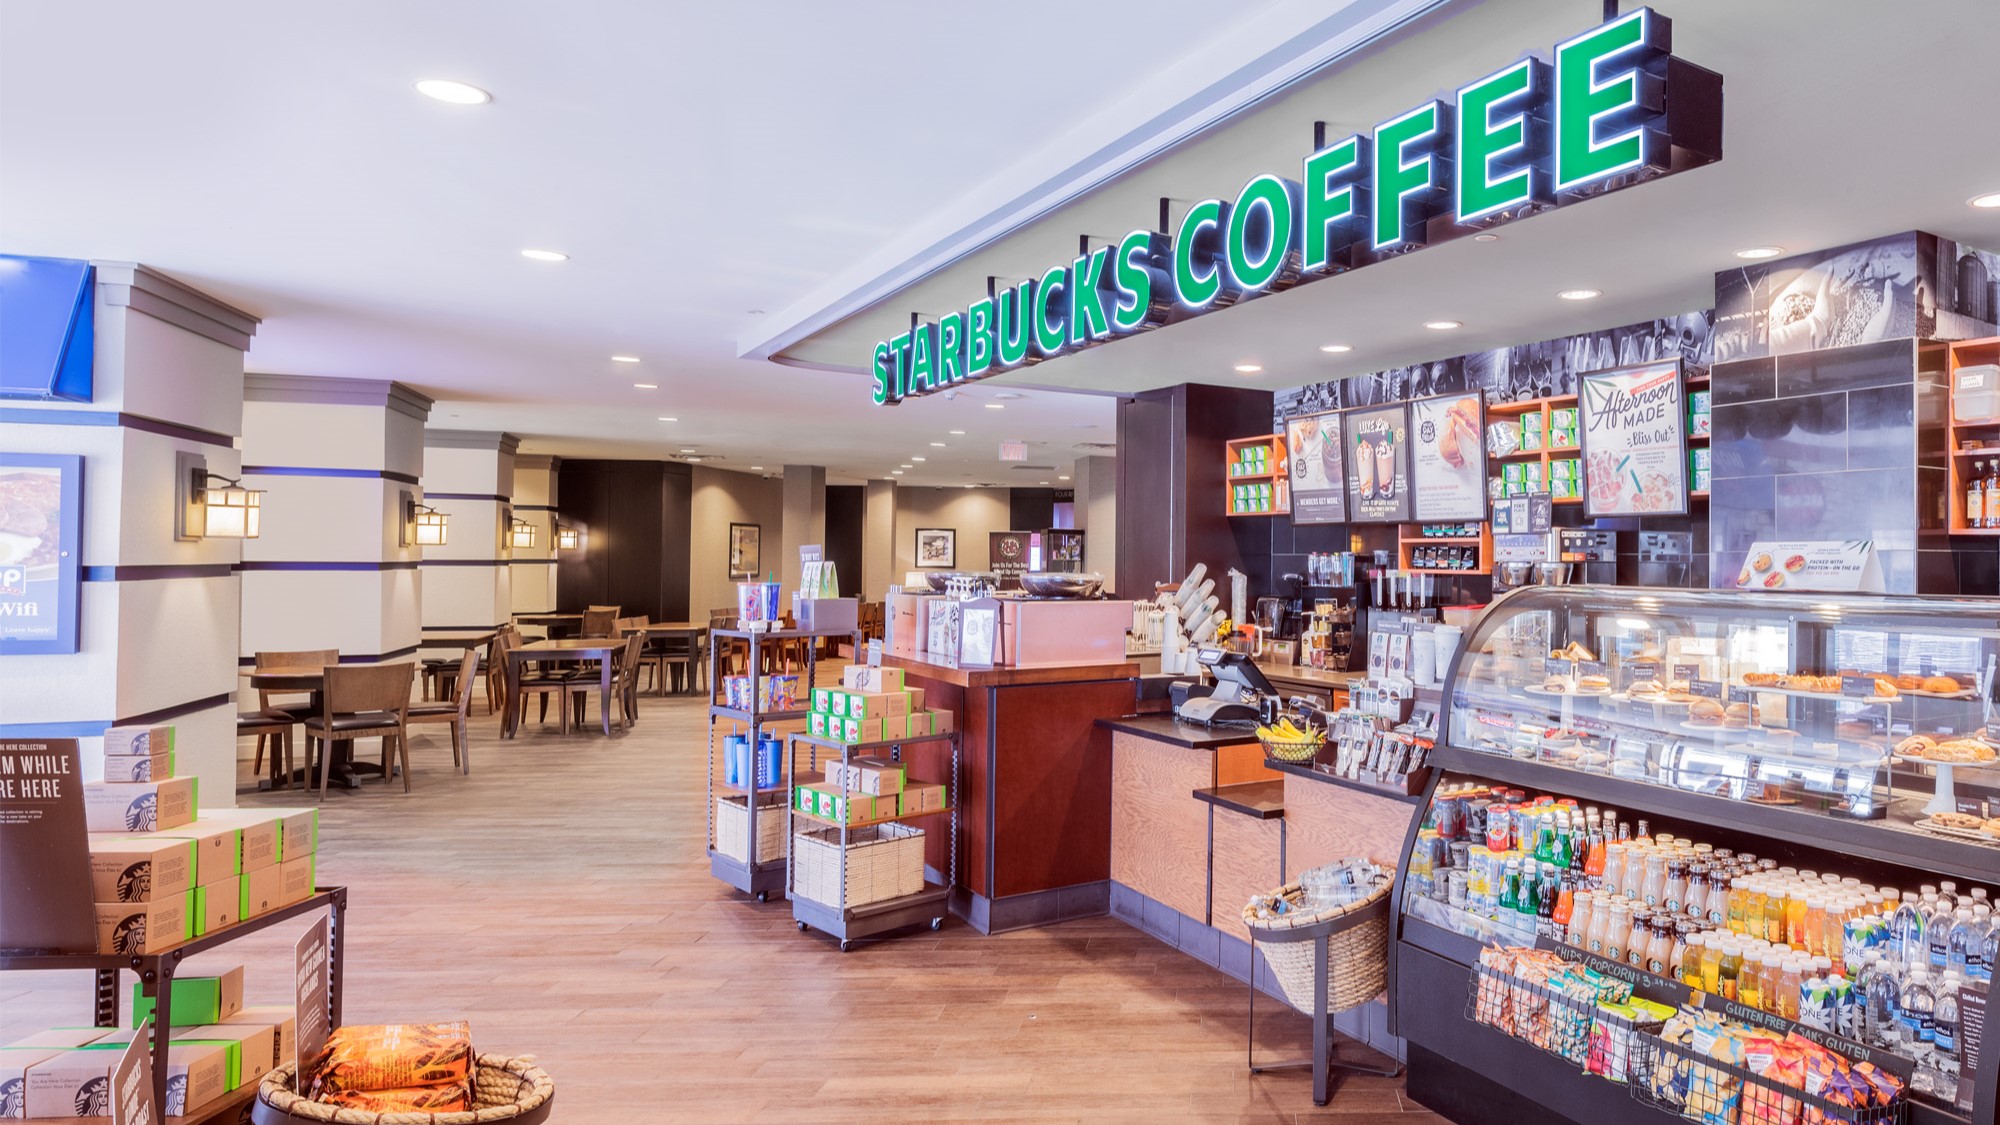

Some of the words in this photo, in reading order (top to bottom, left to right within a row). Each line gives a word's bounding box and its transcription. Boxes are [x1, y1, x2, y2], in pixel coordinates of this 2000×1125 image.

[872, 229, 1151, 405] STARBUCKS
[1173, 7, 1648, 309] COFFEE
[1589, 381, 1678, 432] Afternoon
[1624, 403, 1665, 430] MADE
[1632, 431, 1651, 446] Bliss
[1654, 429, 1671, 443] Out
[20, 755, 70, 775] WHILE
[21, 779, 61, 798] HERE
[1554, 945, 1582, 963] CHIPS
[1802, 1006, 1822, 1020] OÑE
[1725, 1002, 1763, 1023] GLUTEN
[1764, 1015, 1787, 1031] FREE
[1799, 1027, 1824, 1043] SANS
[1825, 1037, 1870, 1061] GLUTEN
